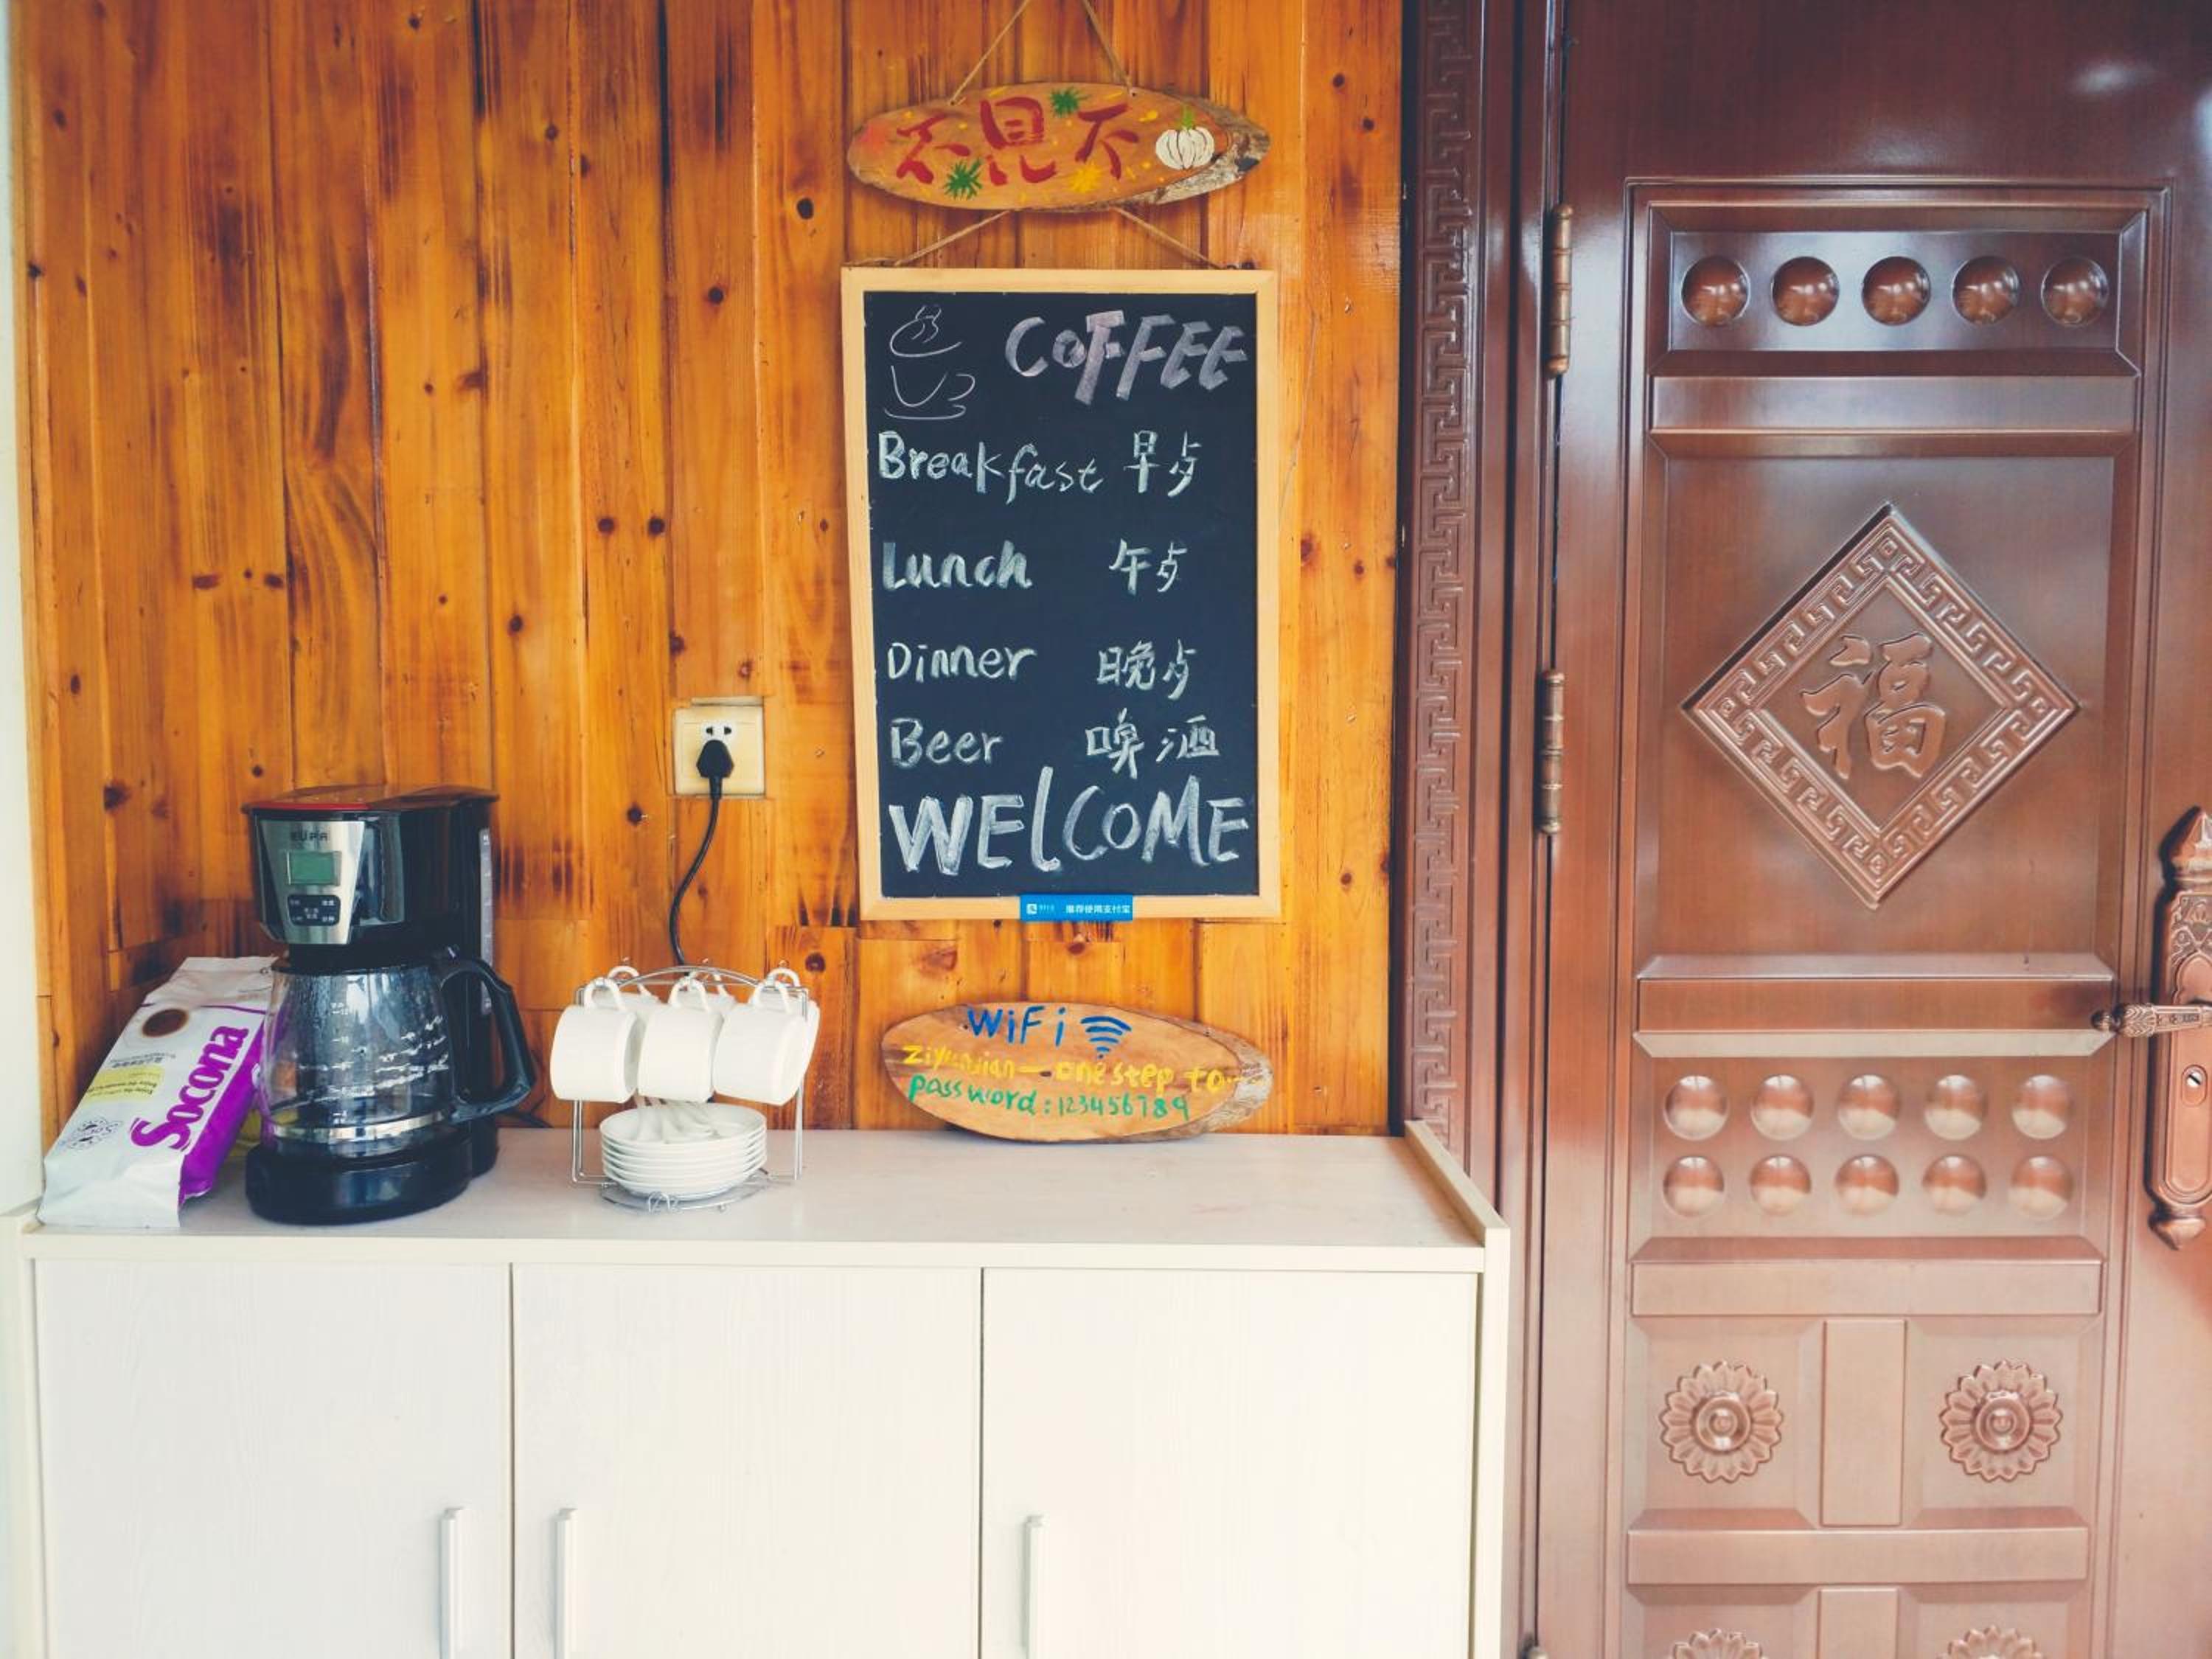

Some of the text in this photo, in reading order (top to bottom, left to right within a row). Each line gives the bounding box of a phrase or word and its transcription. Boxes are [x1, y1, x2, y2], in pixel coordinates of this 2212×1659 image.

[878, 430, 1105, 505] Breakfast
[883, 540, 1033, 592] Lunch
[886, 642, 1037, 683] Dinner
[1801, 633, 1947, 780] 福
[890, 717, 1003, 768] Beer
[130, 1025, 250, 1152] Socona
[1110, 1061, 1175, 1098] step
